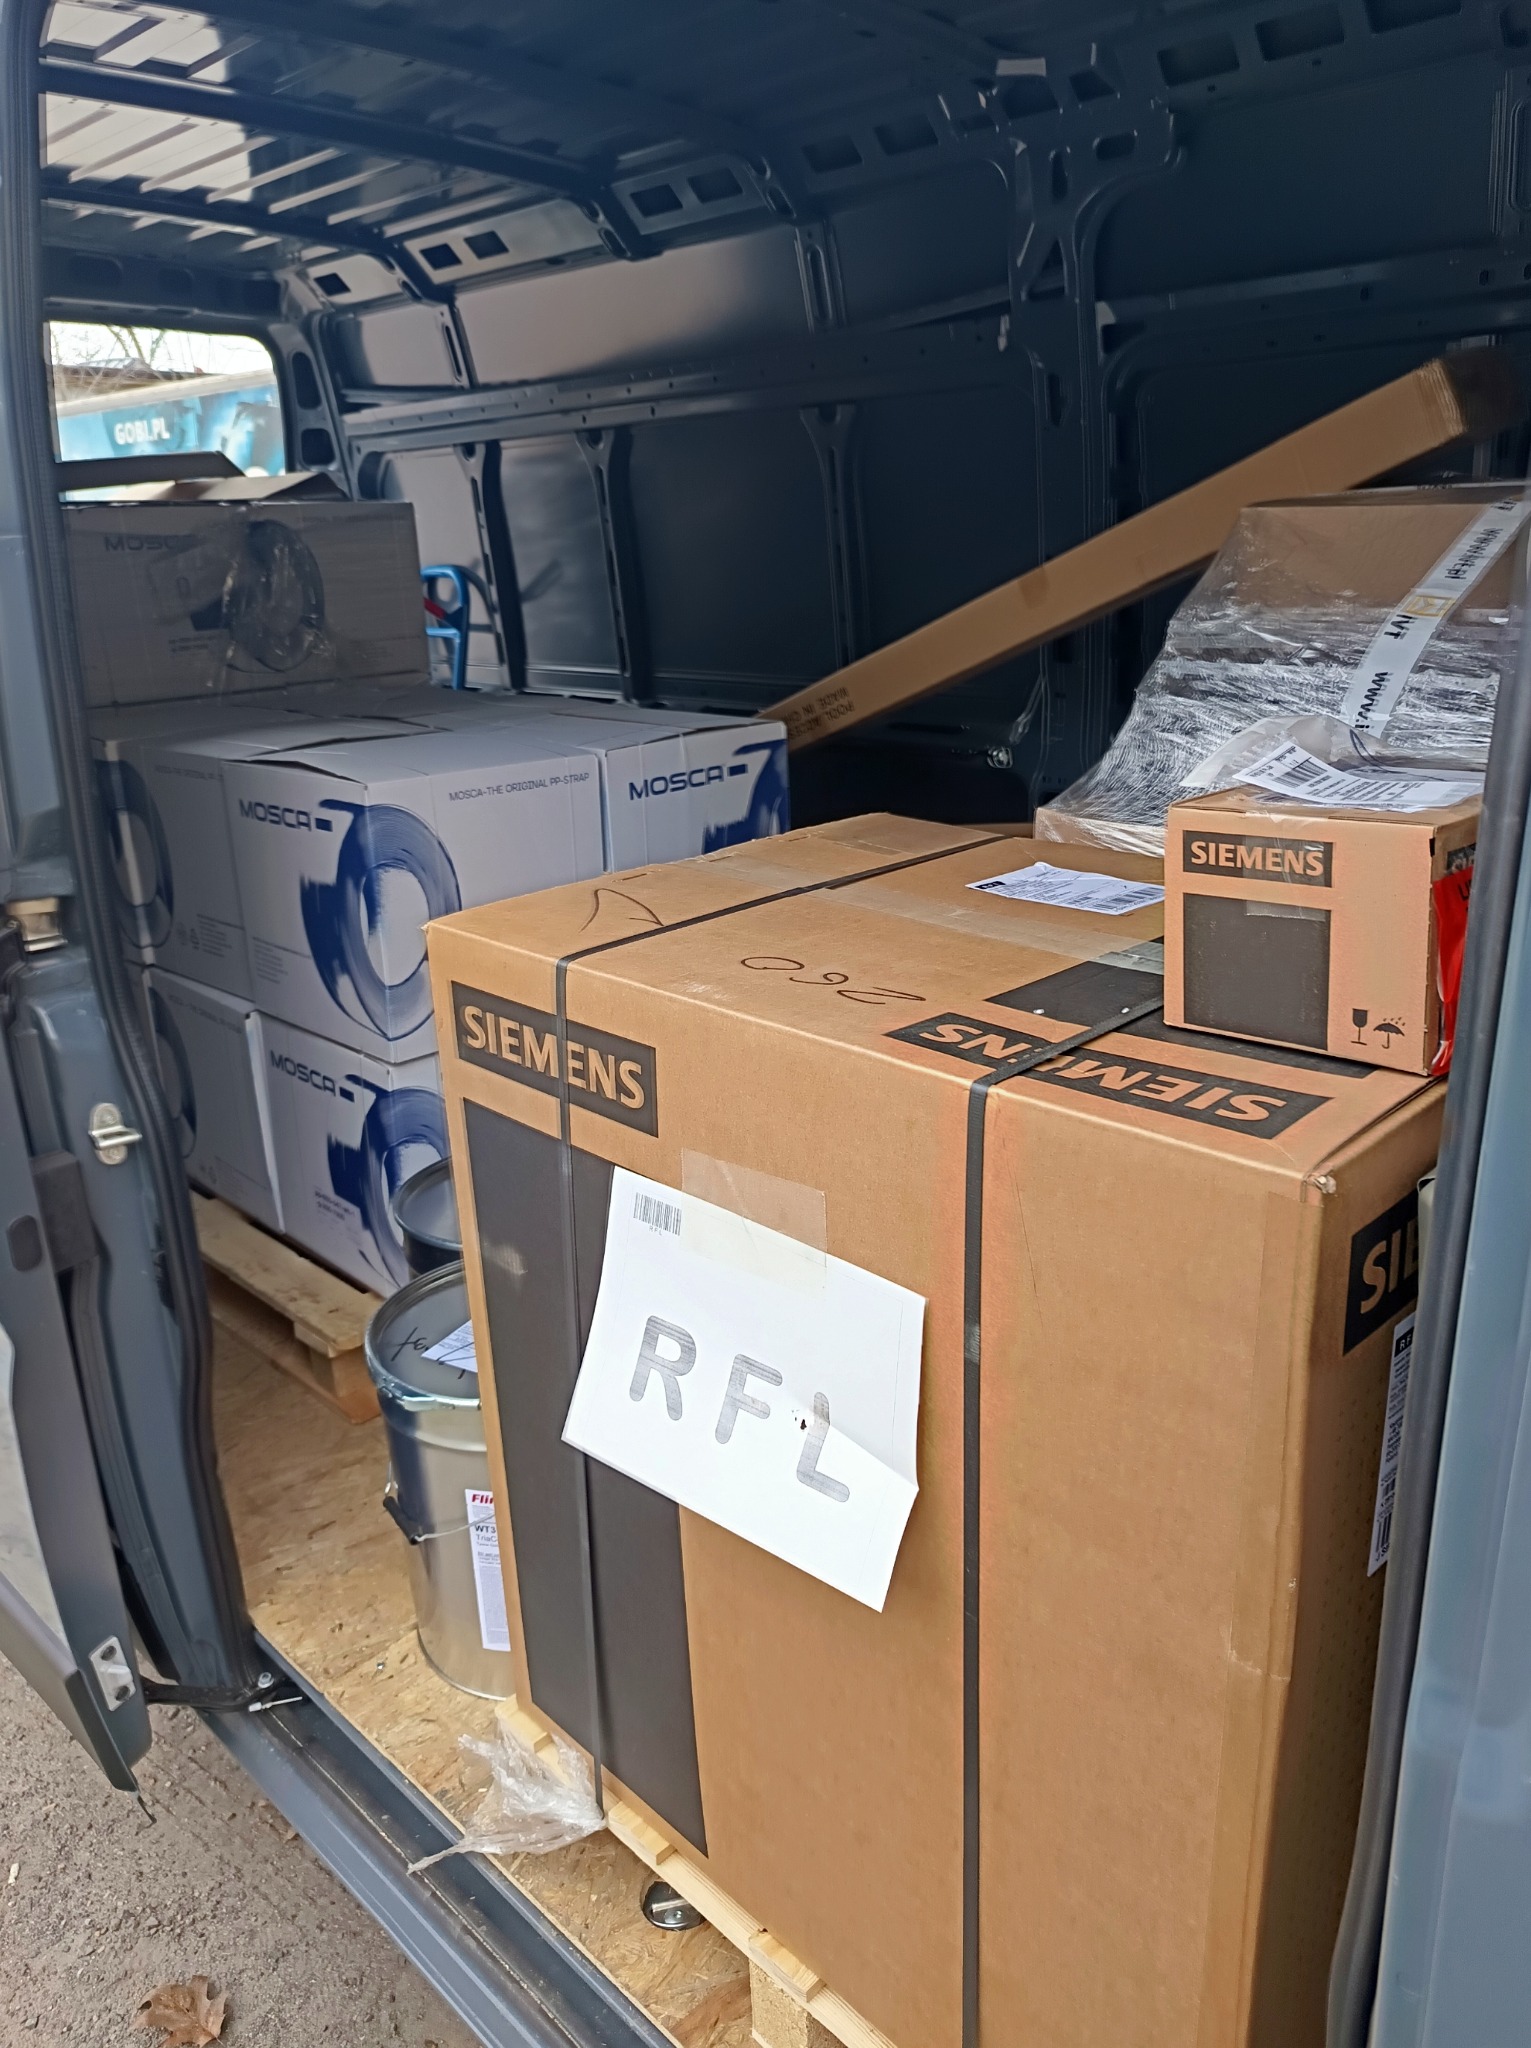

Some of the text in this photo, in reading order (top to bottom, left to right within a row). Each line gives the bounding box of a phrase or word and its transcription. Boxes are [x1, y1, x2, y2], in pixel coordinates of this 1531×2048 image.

[1384, 614, 1415, 640] IVT
[1355, 672, 1390, 729] www.i
[448, 772, 589, 802] MOSCA-THE ORIGINAL PP-STRAP
[629, 765, 724, 801] MOSCA
[238, 799, 312, 832] MOSCA
[1190, 840, 1324, 877] SIEMENS
[270, 1050, 336, 1098] MOSCA
[462, 1005, 645, 1109] SIEMENS
